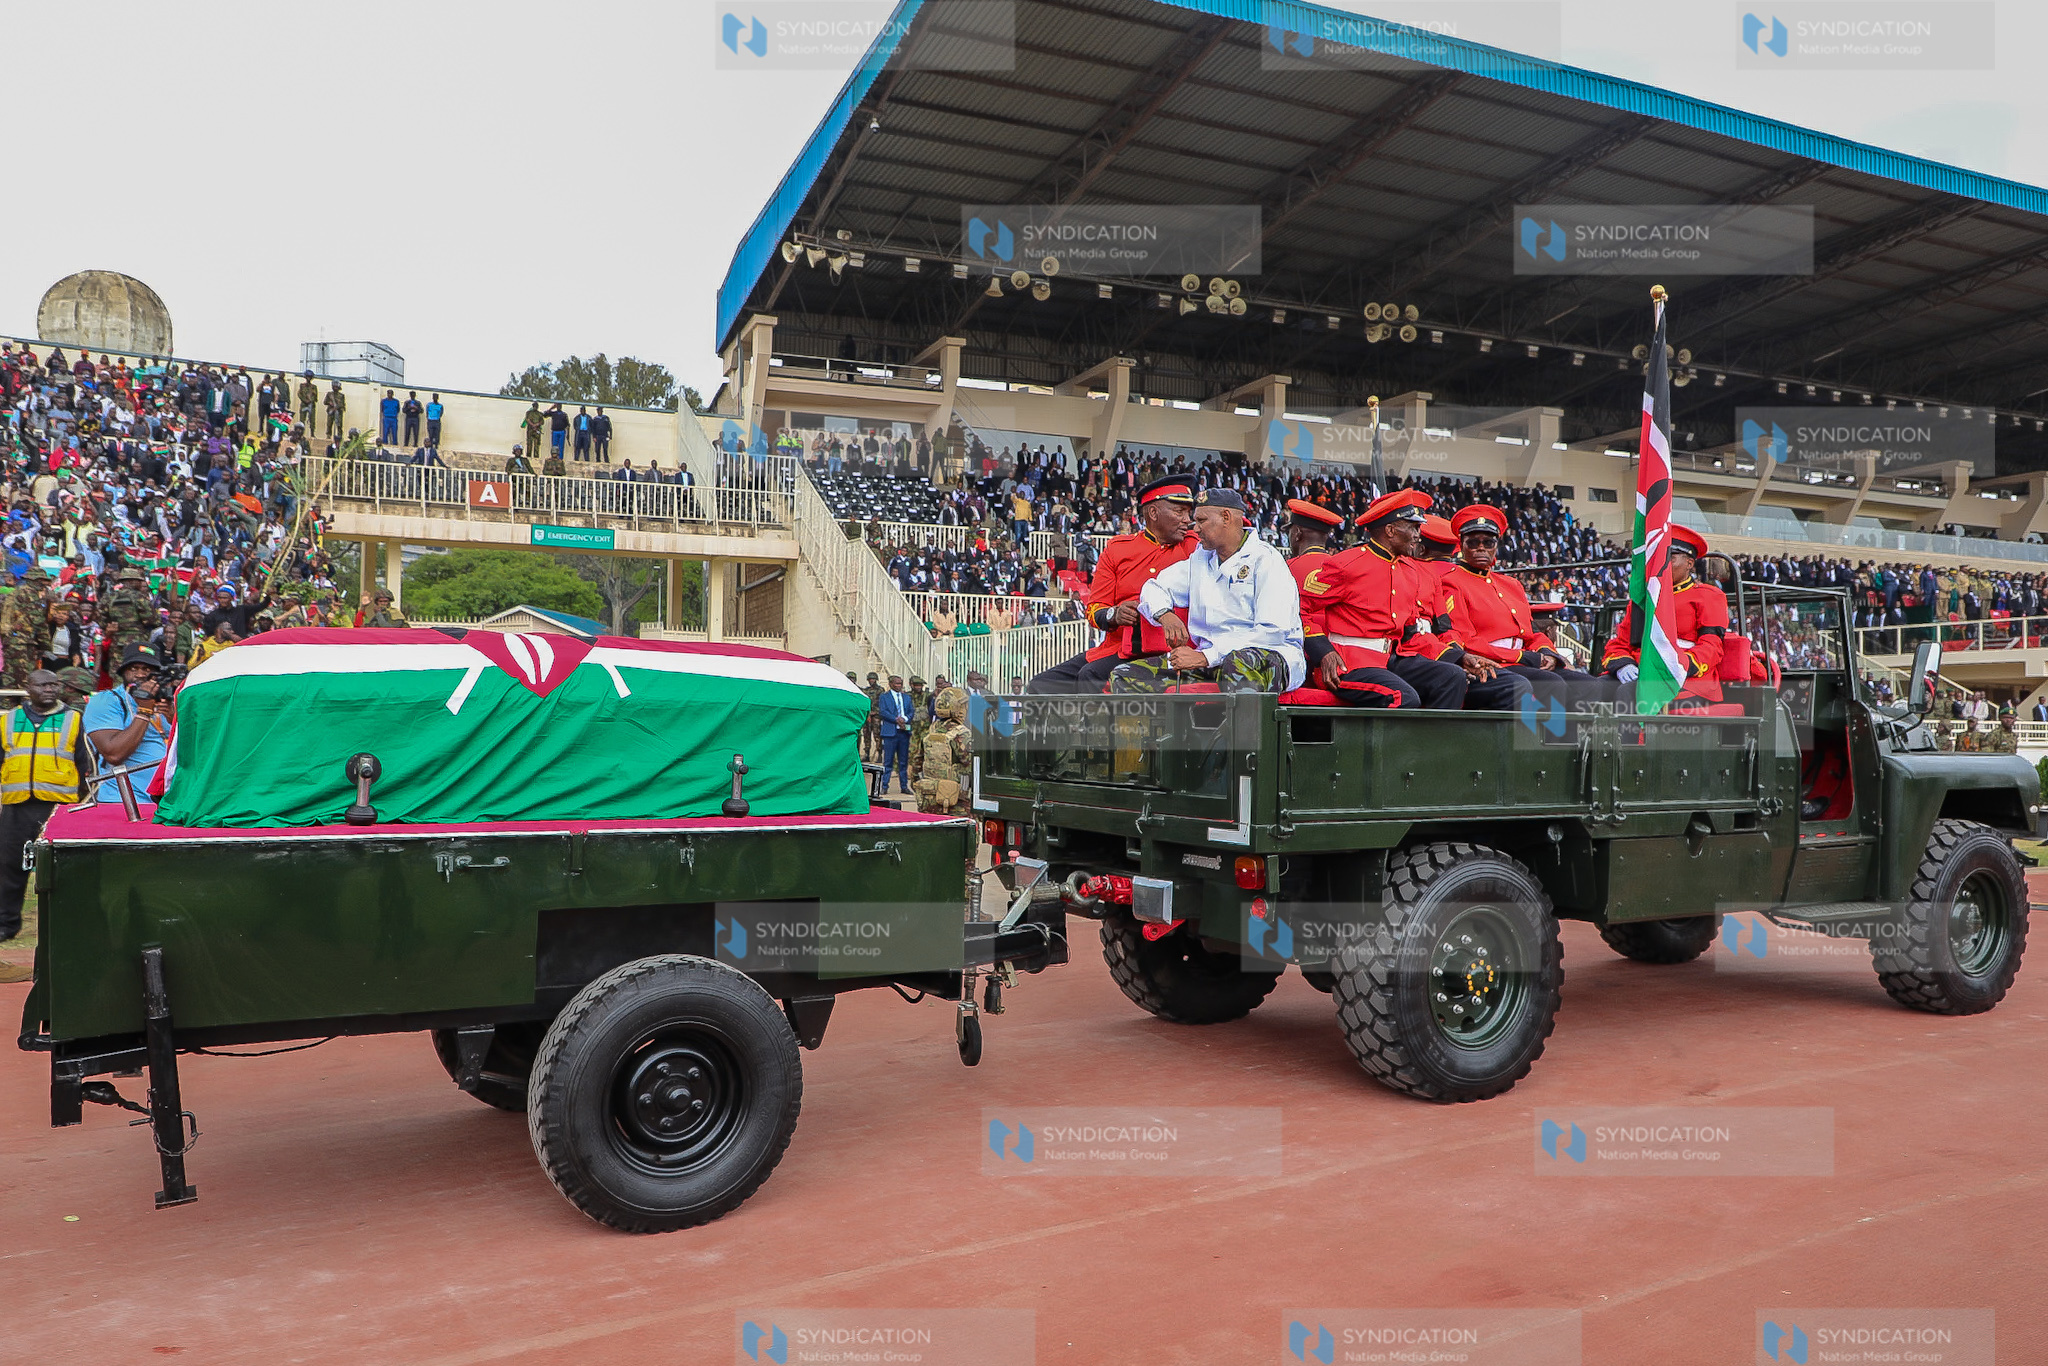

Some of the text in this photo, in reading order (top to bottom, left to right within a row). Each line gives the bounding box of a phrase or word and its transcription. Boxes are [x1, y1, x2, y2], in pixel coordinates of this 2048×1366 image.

[479, 484, 499, 504] A
[547, 532, 611, 544] EMERGENCY EXIT
